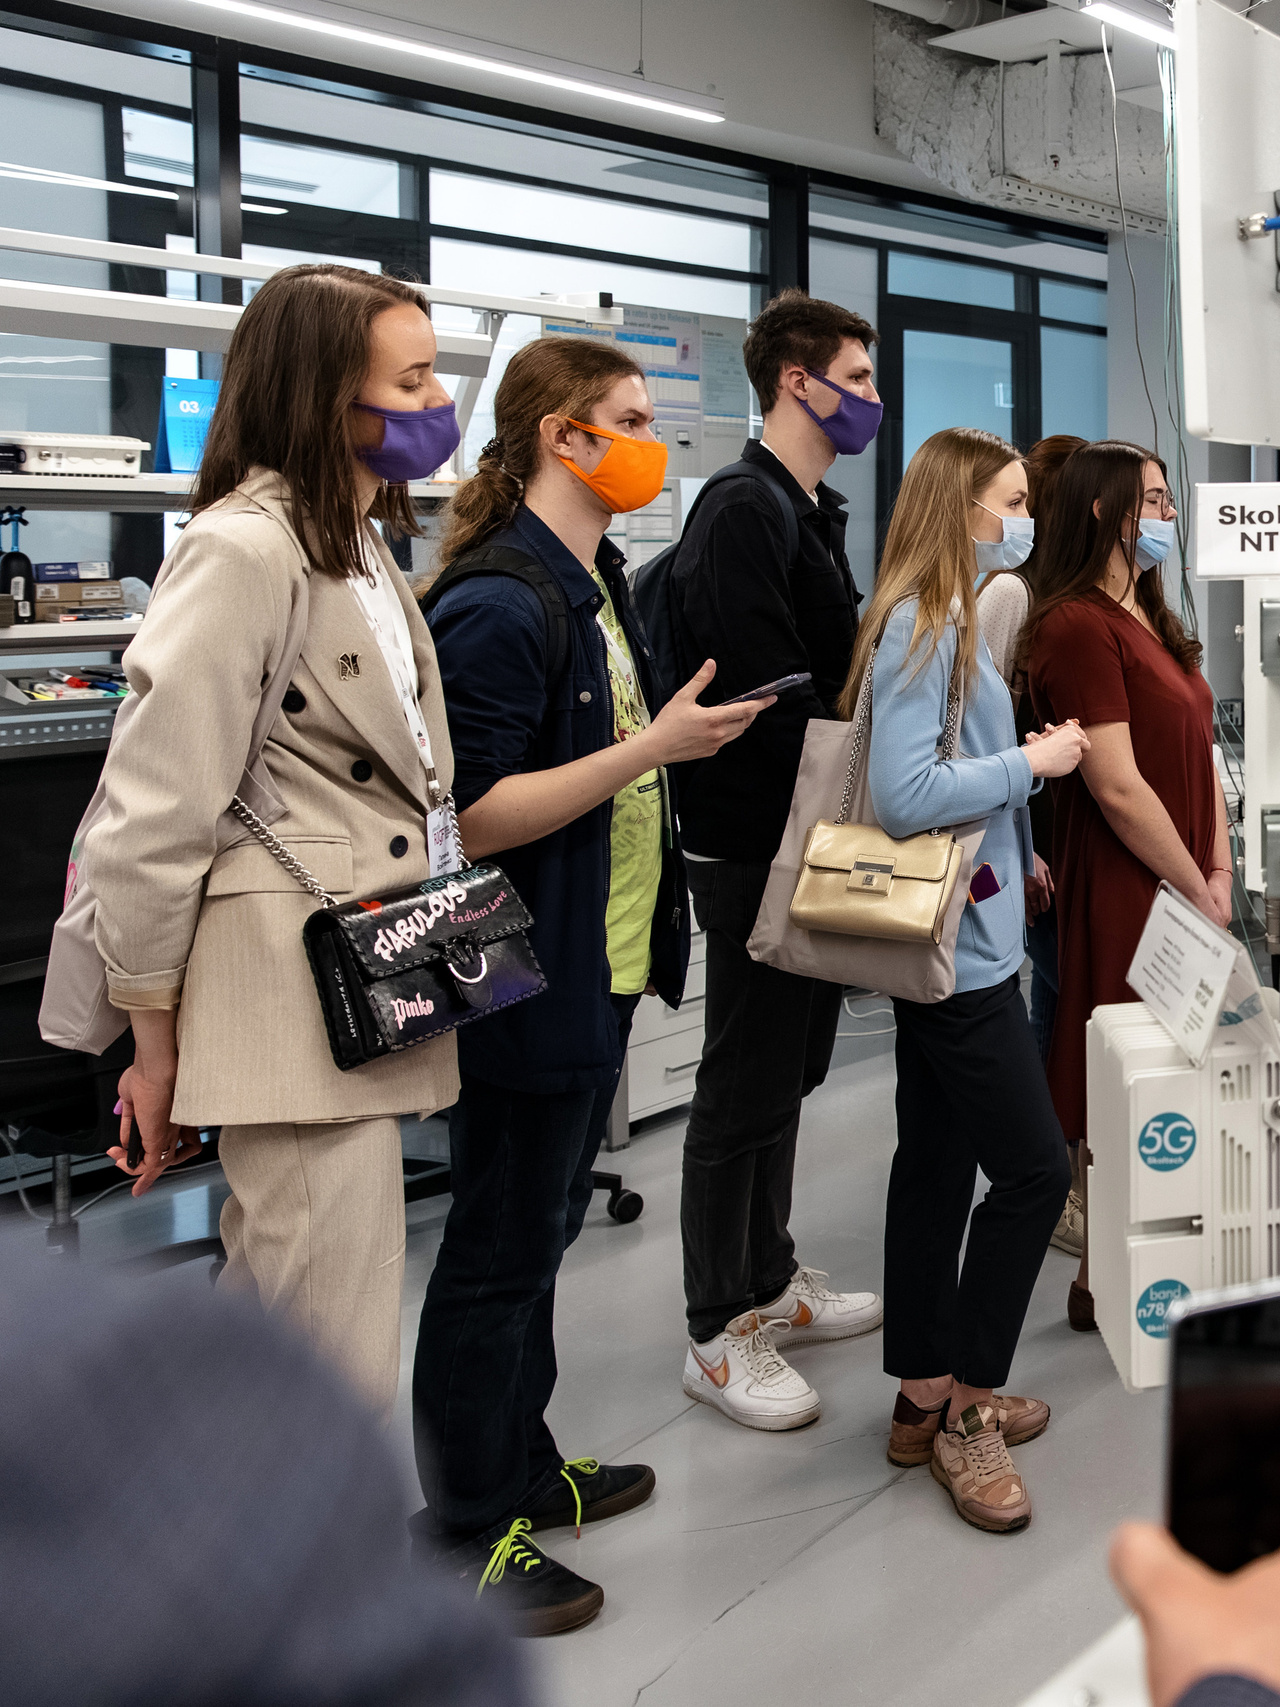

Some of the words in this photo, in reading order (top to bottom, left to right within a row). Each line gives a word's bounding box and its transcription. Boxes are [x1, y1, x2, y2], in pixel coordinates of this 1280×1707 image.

[179, 400, 200, 413] 03
[373, 880, 467, 962] FABULOUS
[448, 908, 489, 924] Endless
[1140, 1121, 1193, 1154] 5G
[1149, 1284, 1181, 1301] band
